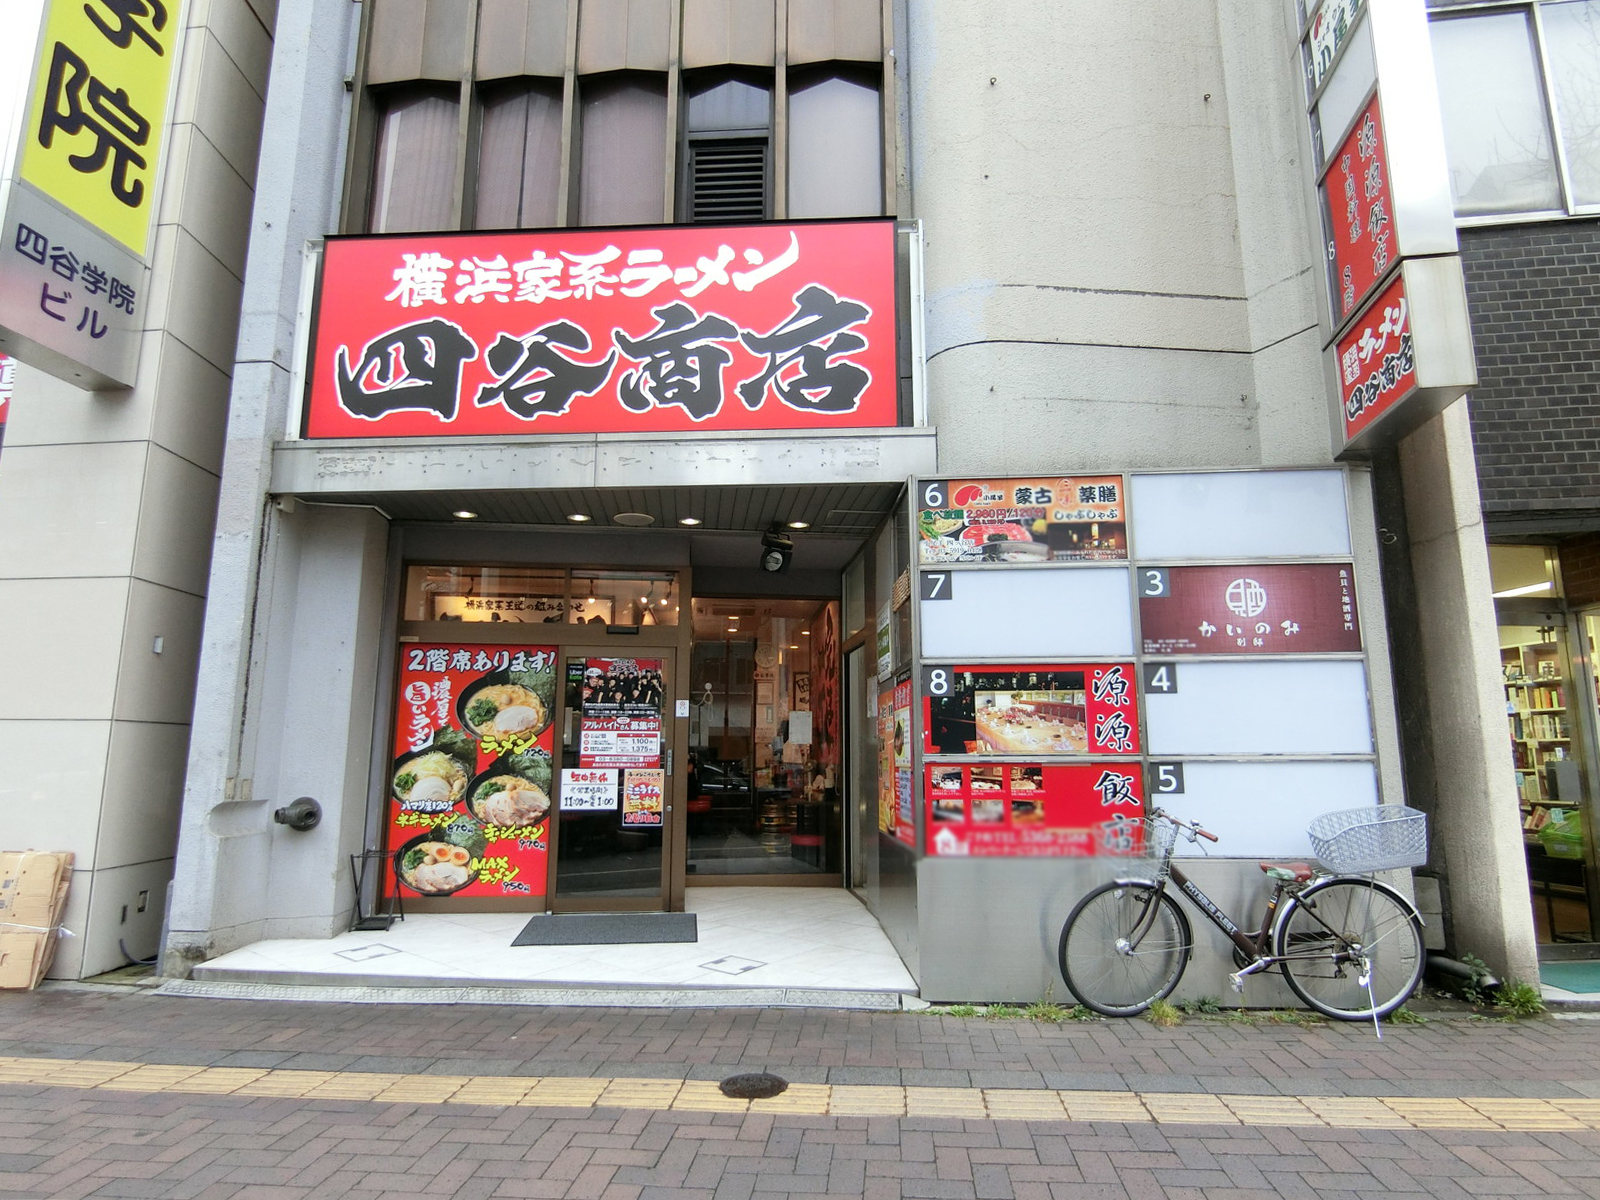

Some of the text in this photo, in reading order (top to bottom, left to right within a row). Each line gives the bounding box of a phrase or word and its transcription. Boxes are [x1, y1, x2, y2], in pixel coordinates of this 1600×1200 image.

[1308, 59, 1314, 78] 6
[1315, 130, 1321, 151] 7
[1357, 112, 1389, 277] 源源飯店
[1328, 240, 1336, 261] 8
[15, 222, 136, 316] 四谷学院
[384, 230, 800, 308] 横浜家系ラーメン
[39, 281, 108, 340] ビル
[1358, 297, 1407, 366] ラーメン
[336, 283, 874, 422] 四谷商店
[1345, 332, 1414, 421] 四谷商店
[924, 483, 944, 508] 6
[1014, 487, 1053, 505] 蒙古
[1078, 485, 1118, 504] 薬膳
[1053, 508, 1118, 520] しゃぶしゃぶ
[928, 575, 946, 598] 7
[1144, 570, 1165, 596] 3
[1198, 620, 1300, 638] かいのみ
[929, 669, 950, 695] 8
[1149, 666, 1171, 691] 4
[1091, 664, 1131, 753] 源源
[480, 731, 538, 757] ラーメン
[1158, 765, 1178, 790] 5
[395, 811, 459, 829] ネギラーメン
[470, 856, 509, 871] MAX
[478, 865, 520, 885] ラーメン
